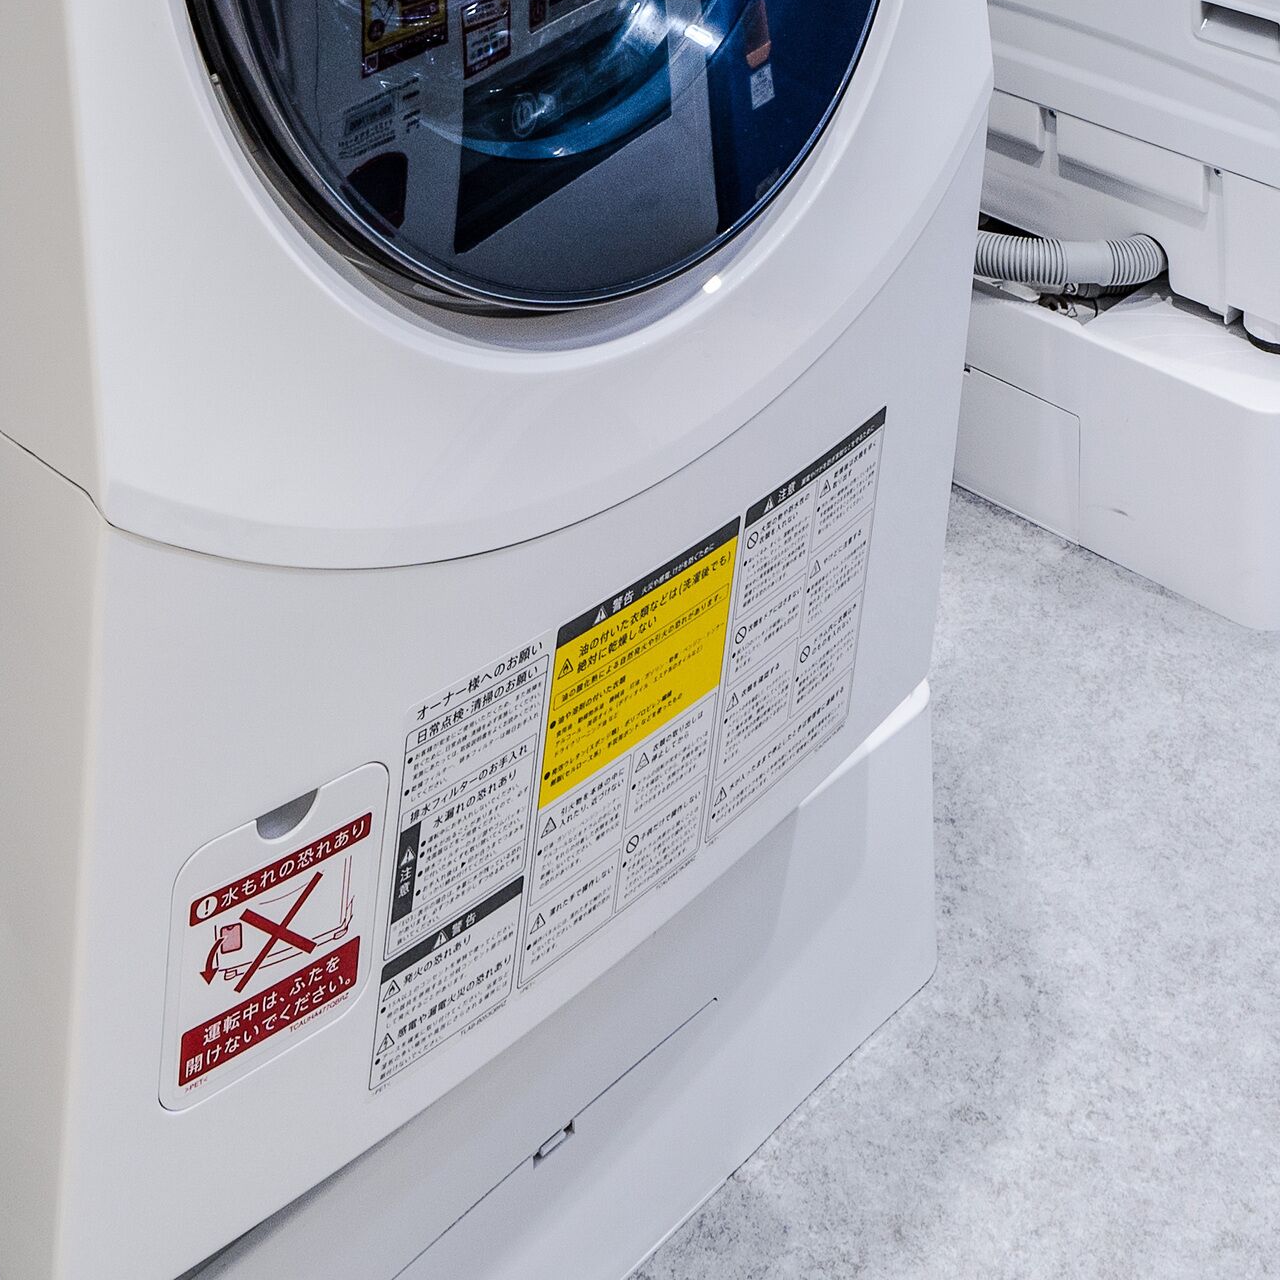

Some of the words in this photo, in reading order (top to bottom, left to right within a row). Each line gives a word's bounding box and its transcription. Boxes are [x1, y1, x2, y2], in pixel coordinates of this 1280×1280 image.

[778, 481, 796, 503] 注意
[612, 590, 634, 613] 警告
[577, 616, 657, 674] 絶対に乾燥しない
[416, 642, 542, 721] オーナー様へのお願い
[417, 666, 538, 744] 日常点検・清掃のお願い
[410, 744, 528, 824] 排水フィルターのお手入れ
[433, 770, 517, 828] 水漏れの恐れあり
[221, 820, 366, 908] 水もれの恐れあり
[398, 866, 413, 898] 注意
[452, 912, 476, 937] 警告
[404, 934, 471, 986] 発火の恐れあり
[185, 976, 351, 1078] 開けないでください。
[203, 955, 340, 1046] 運転中は、ふたを
